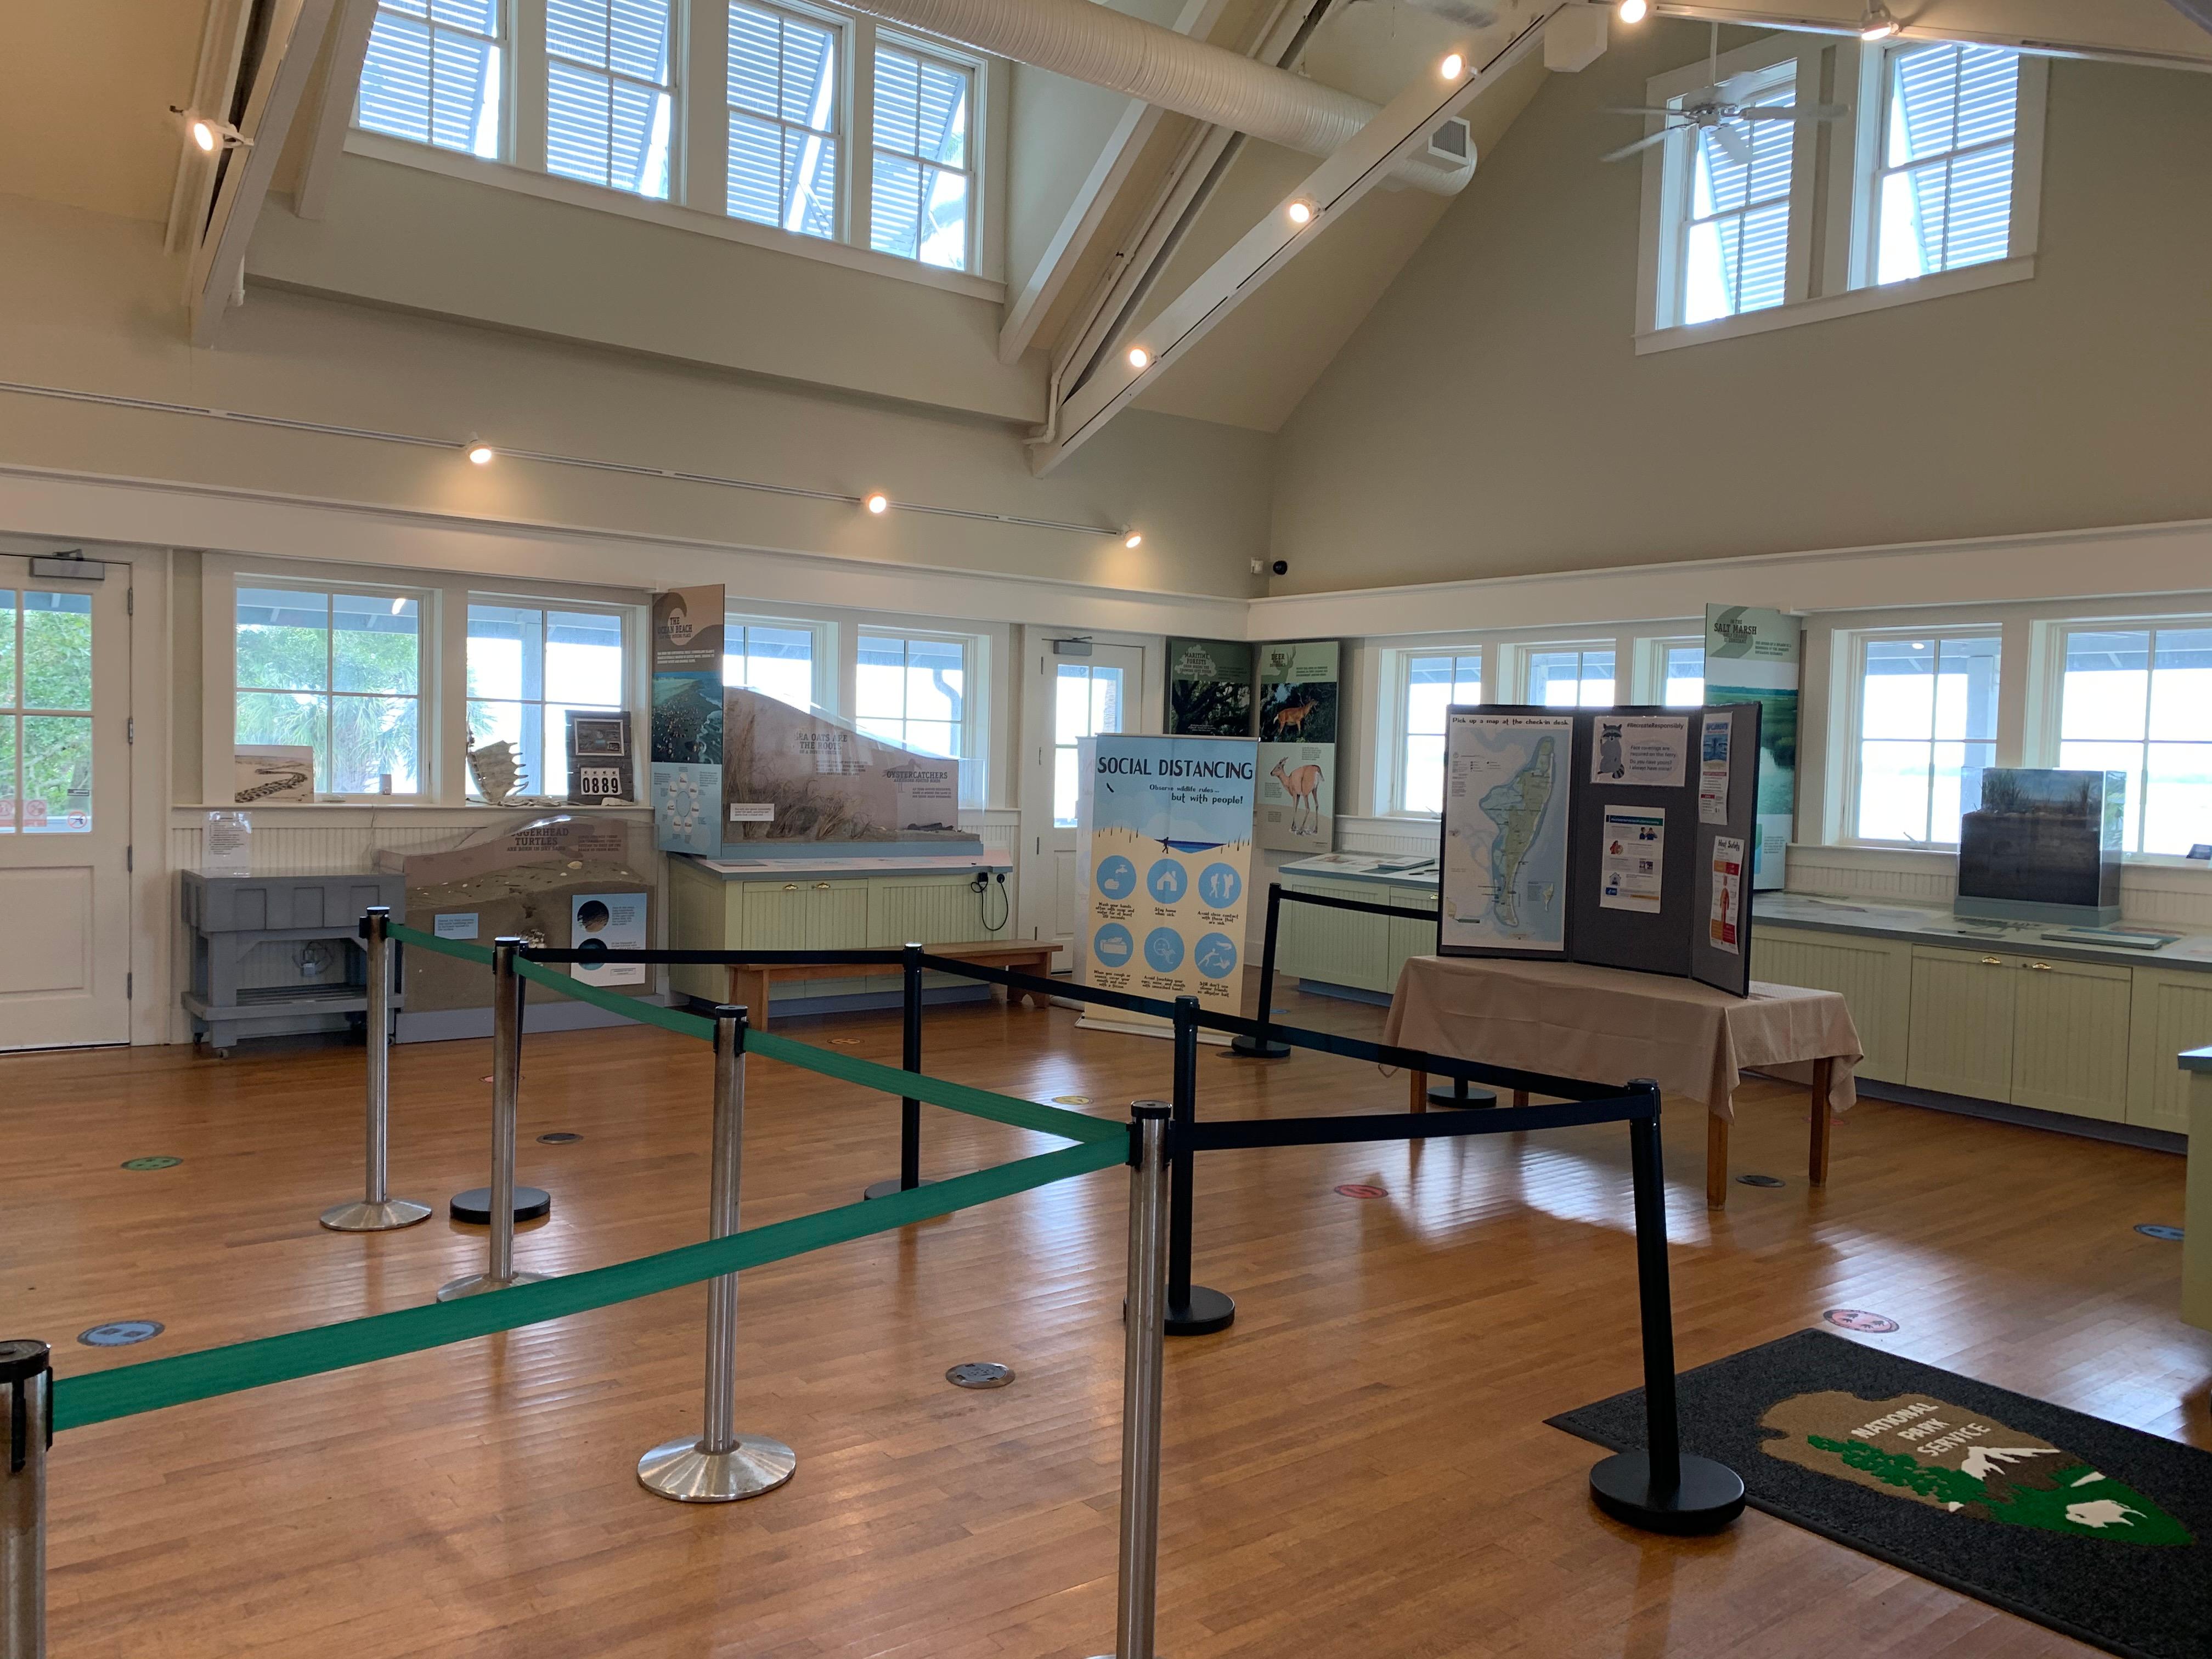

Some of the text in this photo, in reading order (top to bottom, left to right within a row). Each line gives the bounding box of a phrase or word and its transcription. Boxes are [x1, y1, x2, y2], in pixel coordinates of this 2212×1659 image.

[670, 617, 680, 625] THE
[658, 624, 692, 634] OCEAN BEACH
[1714, 623, 1757, 635] SALT MARSH
[811, 733, 830, 742] OATS
[800, 741, 815, 749] THE
[1097, 757, 1253, 780] SOCIAL DISTANCING
[887, 770, 948, 779] OYSTERCATCHERS
[583, 777, 618, 793] 0889
[1171, 793, 1243, 805] but with people!
[515, 837, 558, 846] TURTLES
[1728, 840, 1740, 851] Safety
[1851, 1402, 1939, 1439] NATIONAL
[1897, 1418, 1951, 1441] PARK
[1917, 1423, 1991, 1457] SERVICE
